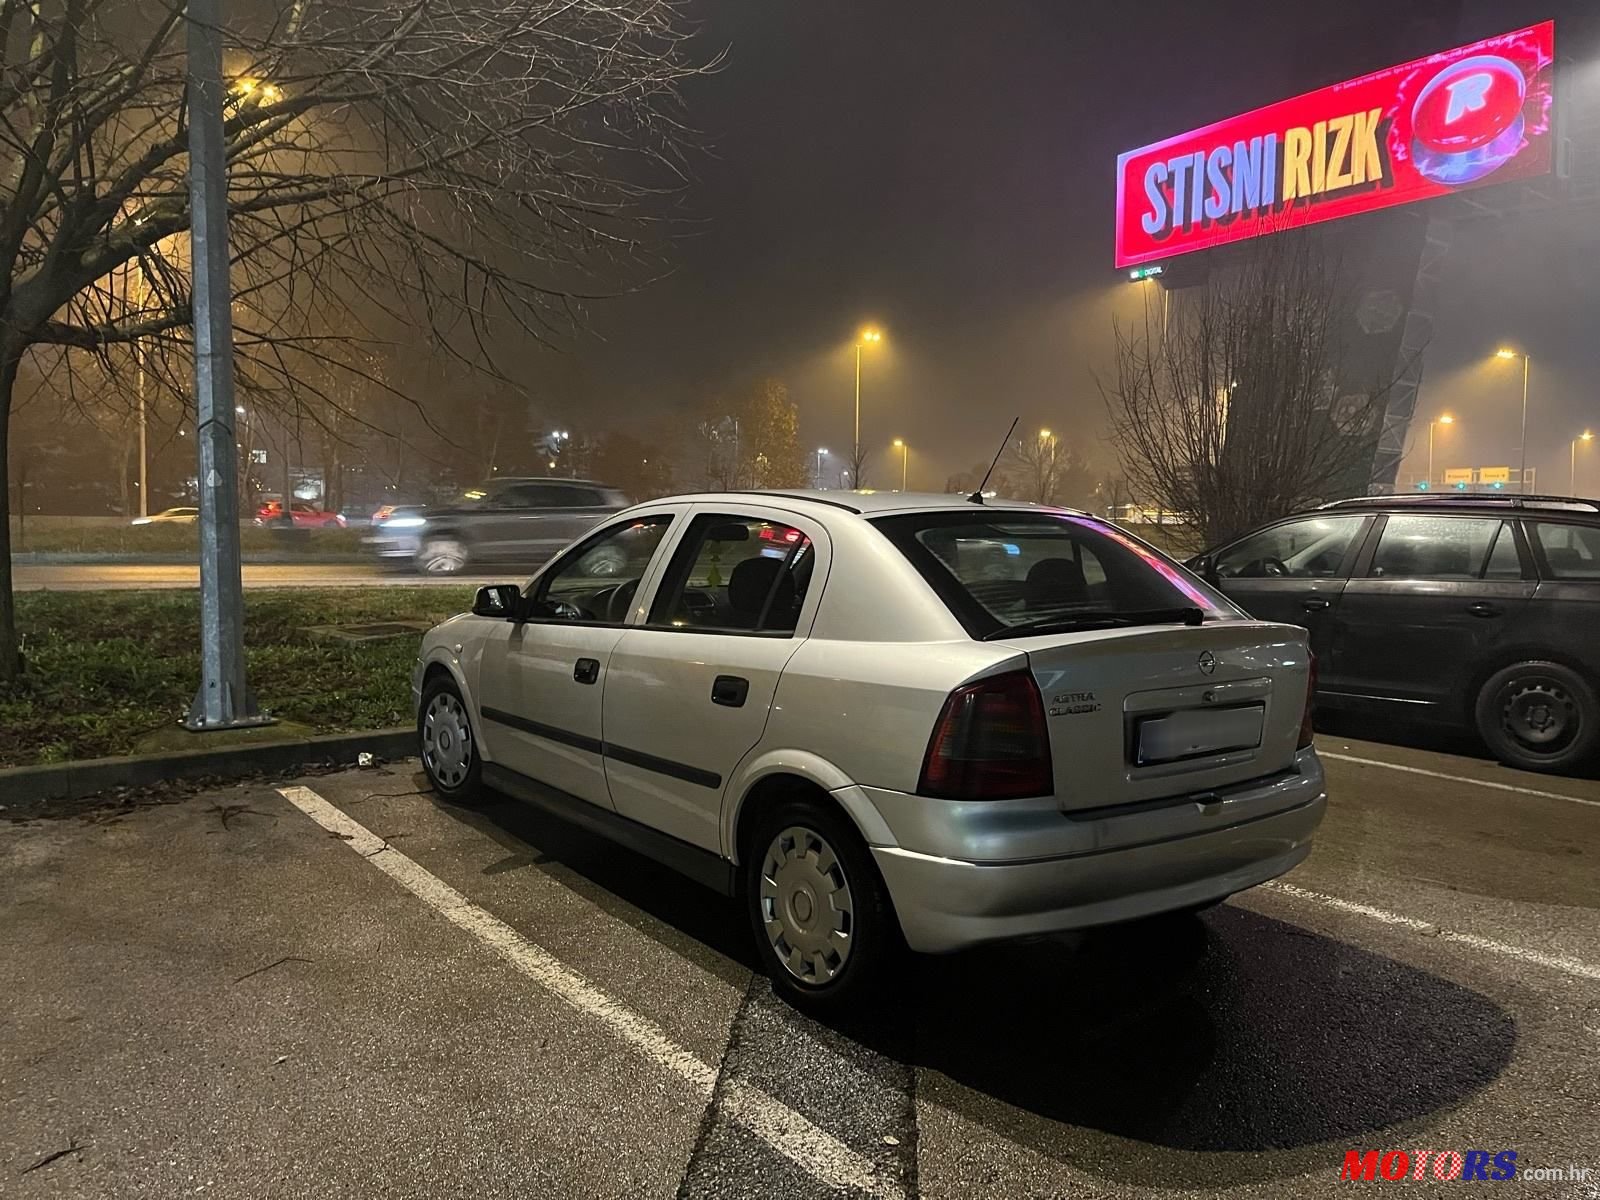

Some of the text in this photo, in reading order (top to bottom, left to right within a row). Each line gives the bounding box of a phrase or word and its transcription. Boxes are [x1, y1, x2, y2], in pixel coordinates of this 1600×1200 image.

[1445, 73, 1493, 125] R
[1141, 107, 1383, 235] STISNI RIZK
[1049, 703, 1102, 716] CLASSIC
[1052, 692, 1096, 704] ASTRA
